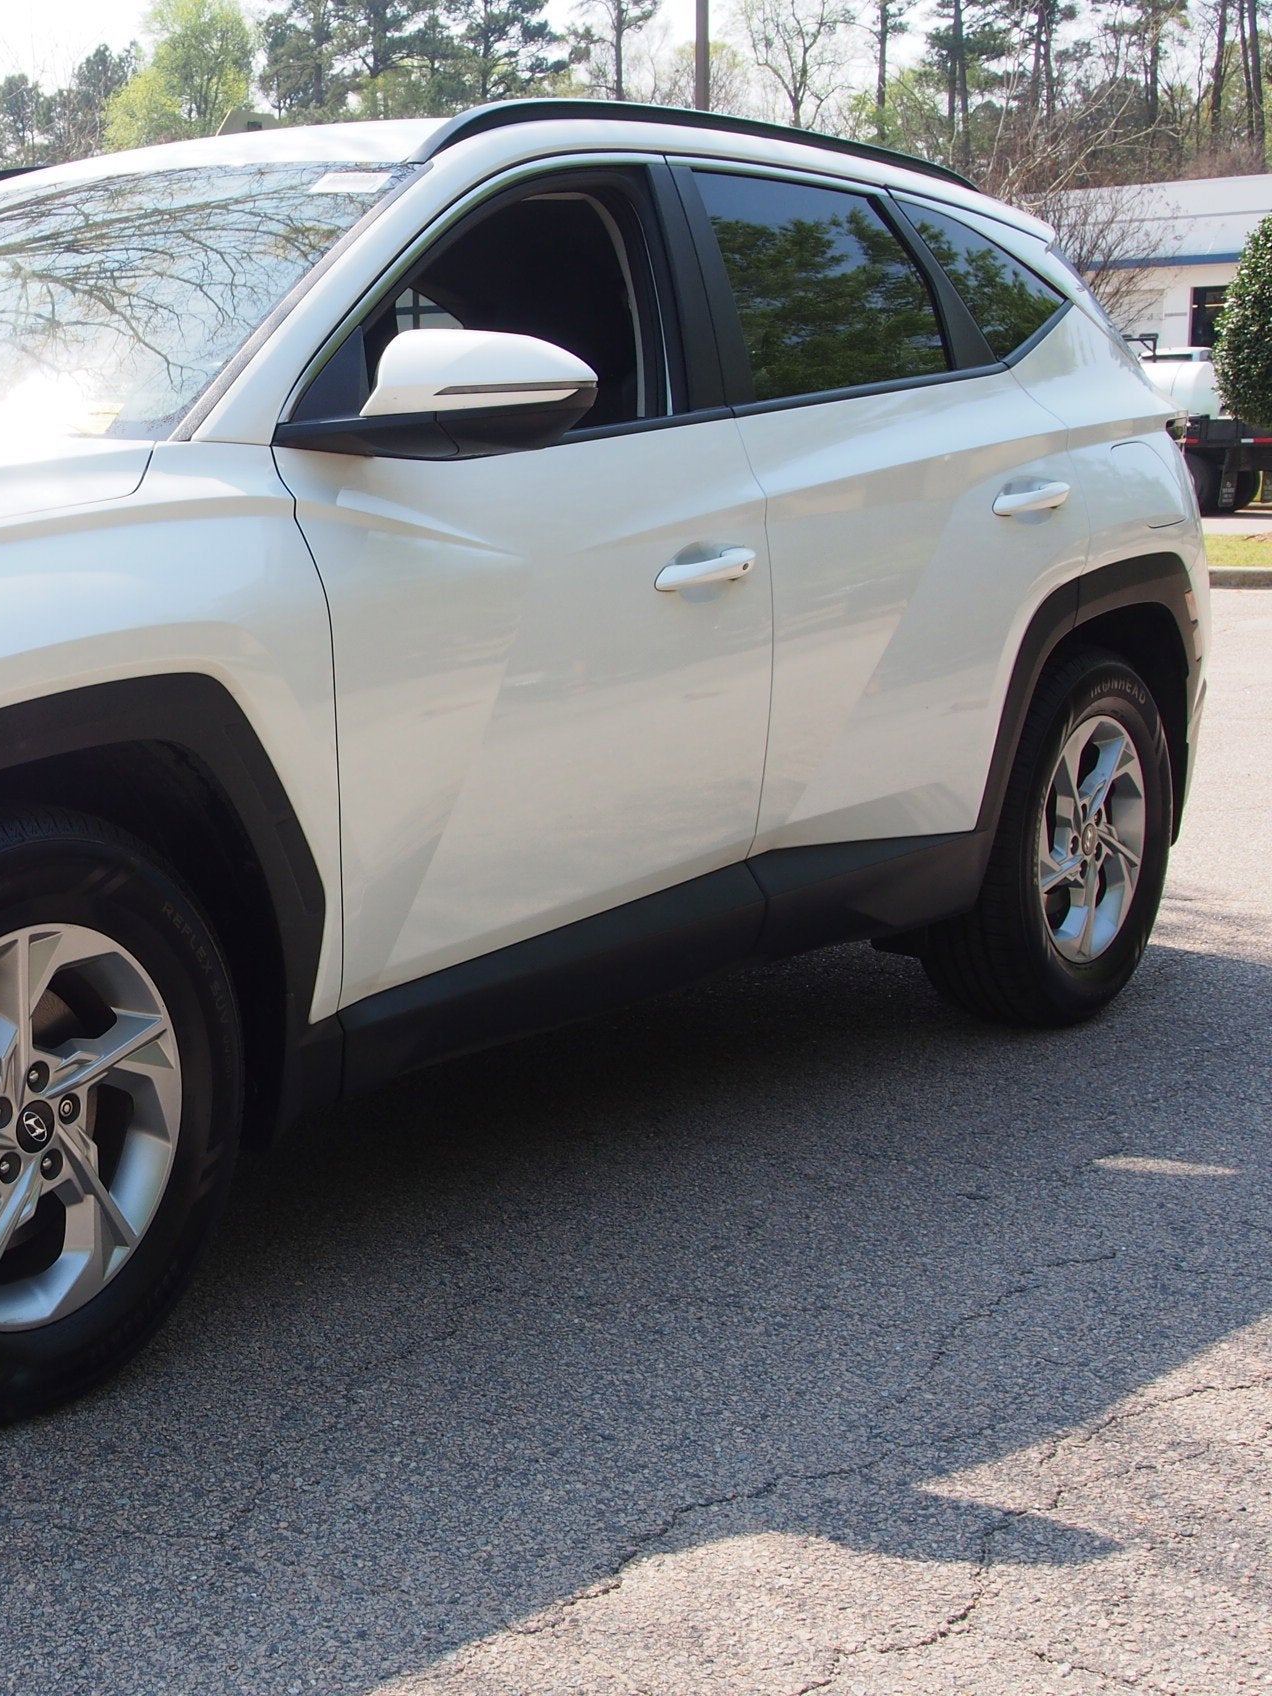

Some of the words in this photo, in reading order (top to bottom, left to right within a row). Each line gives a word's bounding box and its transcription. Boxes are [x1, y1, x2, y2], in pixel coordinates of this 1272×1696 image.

[1090, 677, 1146, 704] IRONHEAD
[161, 901, 214, 977] REFLEX
[209, 980, 230, 1024] SUV
